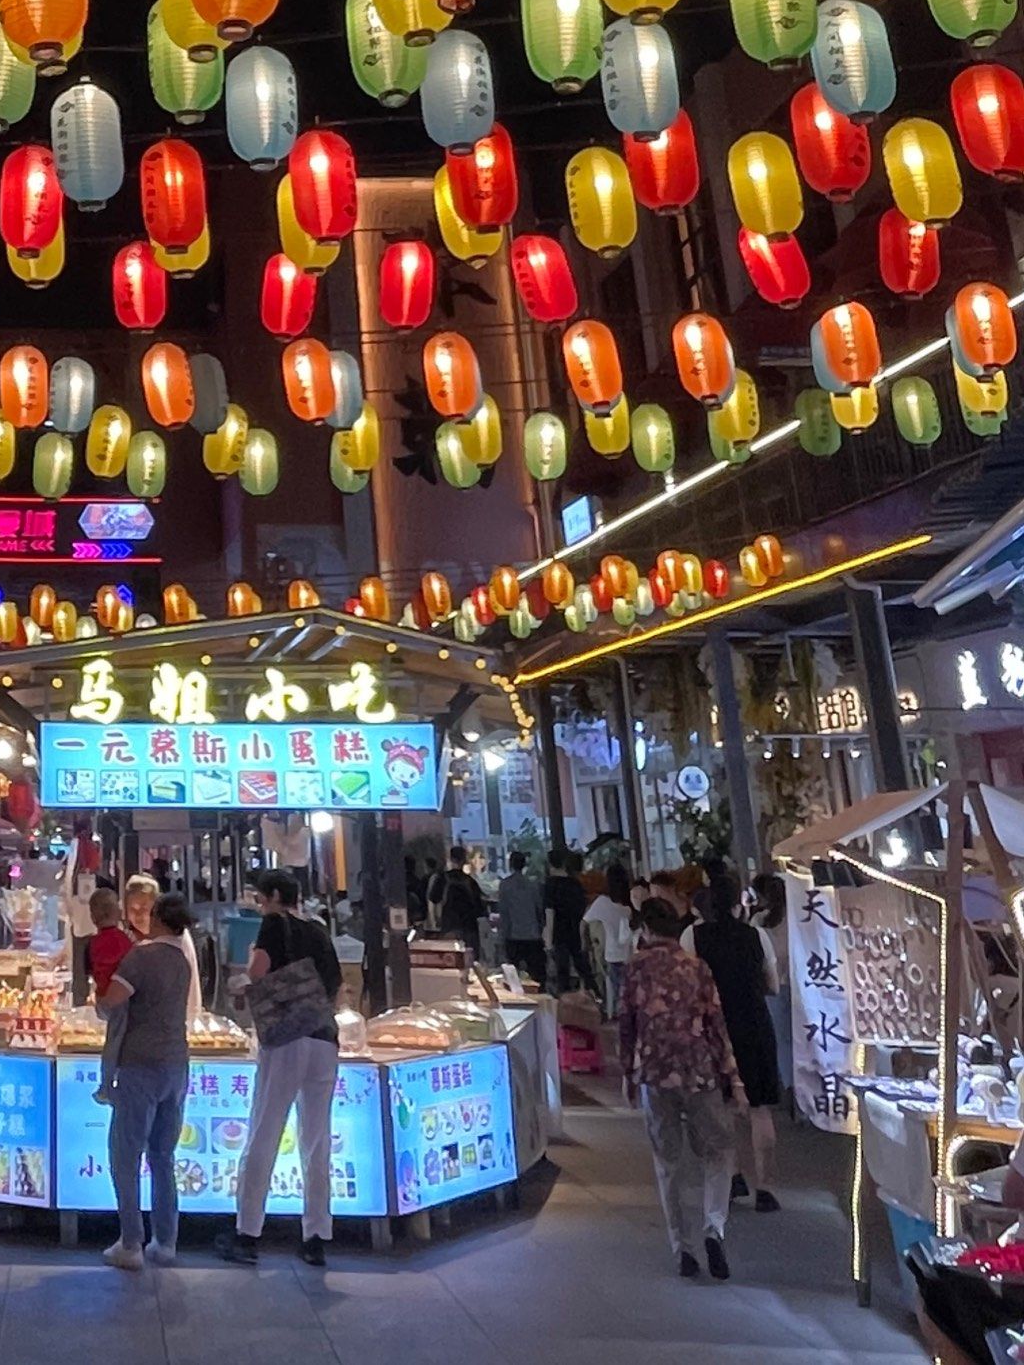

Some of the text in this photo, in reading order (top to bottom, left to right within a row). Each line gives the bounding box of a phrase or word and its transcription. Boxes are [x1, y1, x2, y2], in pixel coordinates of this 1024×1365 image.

[70, 658, 397, 725] 马姐小吃
[55, 728, 372, 766] 一元慕斯小蛋糕
[801, 889, 852, 1121] 天然水晶
